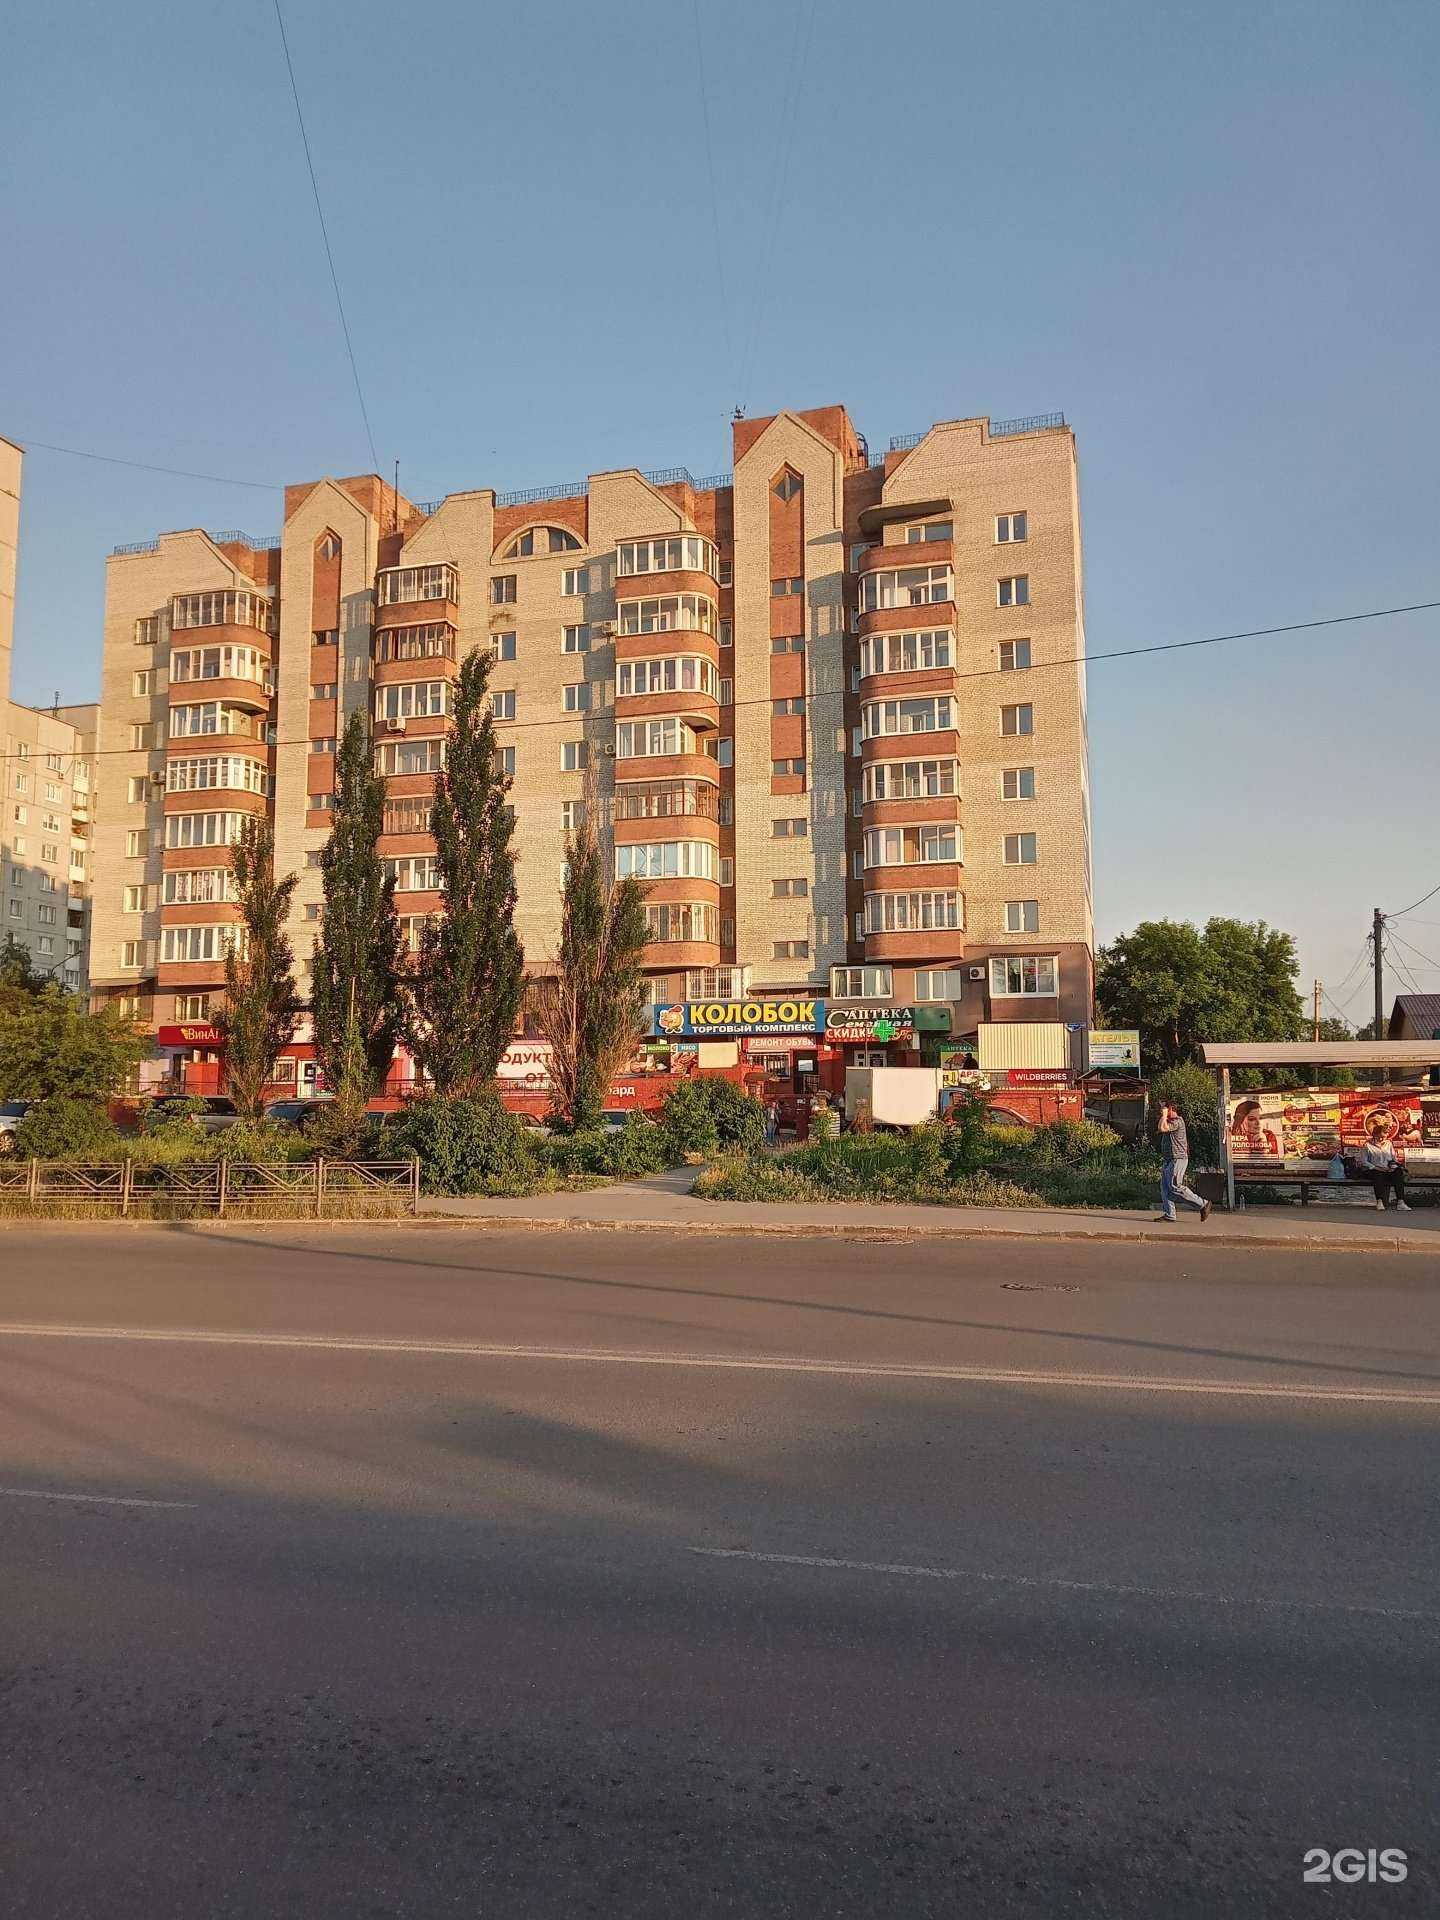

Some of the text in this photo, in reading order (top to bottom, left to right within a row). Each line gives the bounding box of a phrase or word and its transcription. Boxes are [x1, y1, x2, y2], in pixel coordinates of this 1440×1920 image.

[690, 1002, 815, 1024] КОЛОБОК
[847, 1008, 912, 1019] АПТЕКА
[692, 1024, 816, 1034] ТОРГОВЫЙ КОМПЛЕКС
[750, 1038, 784, 1047] РЕМОНТ
[1015, 1073, 1068, 1081] WILDBERRIES
